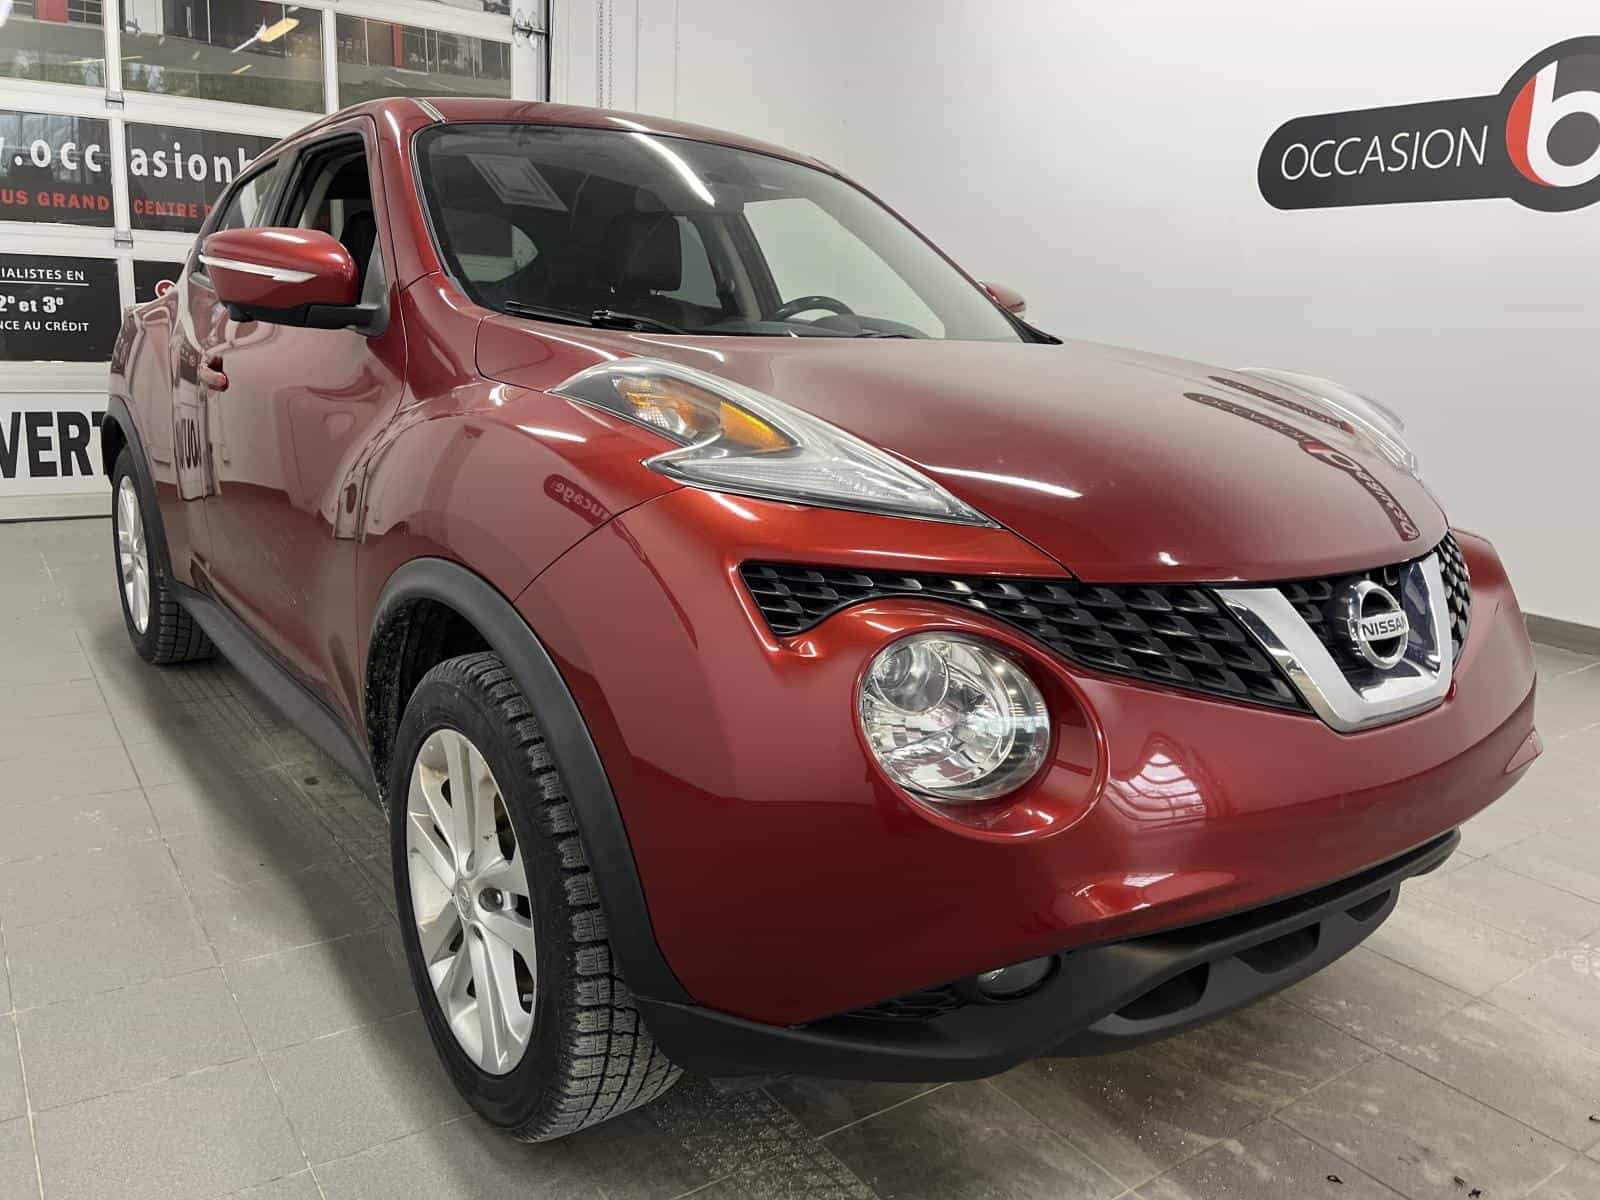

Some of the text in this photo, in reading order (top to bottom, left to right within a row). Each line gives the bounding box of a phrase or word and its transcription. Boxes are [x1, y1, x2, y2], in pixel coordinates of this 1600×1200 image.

[1281, 125, 1488, 180] OCCASION
[37, 191, 110, 211] GRAND
[134, 199, 198, 218] CENTRE
[1, 267, 85, 281] IALISTES EN
[19, 299, 37, 313] et
[24, 320, 41, 331] AU
[45, 319, 89, 332] CRÉDIT
